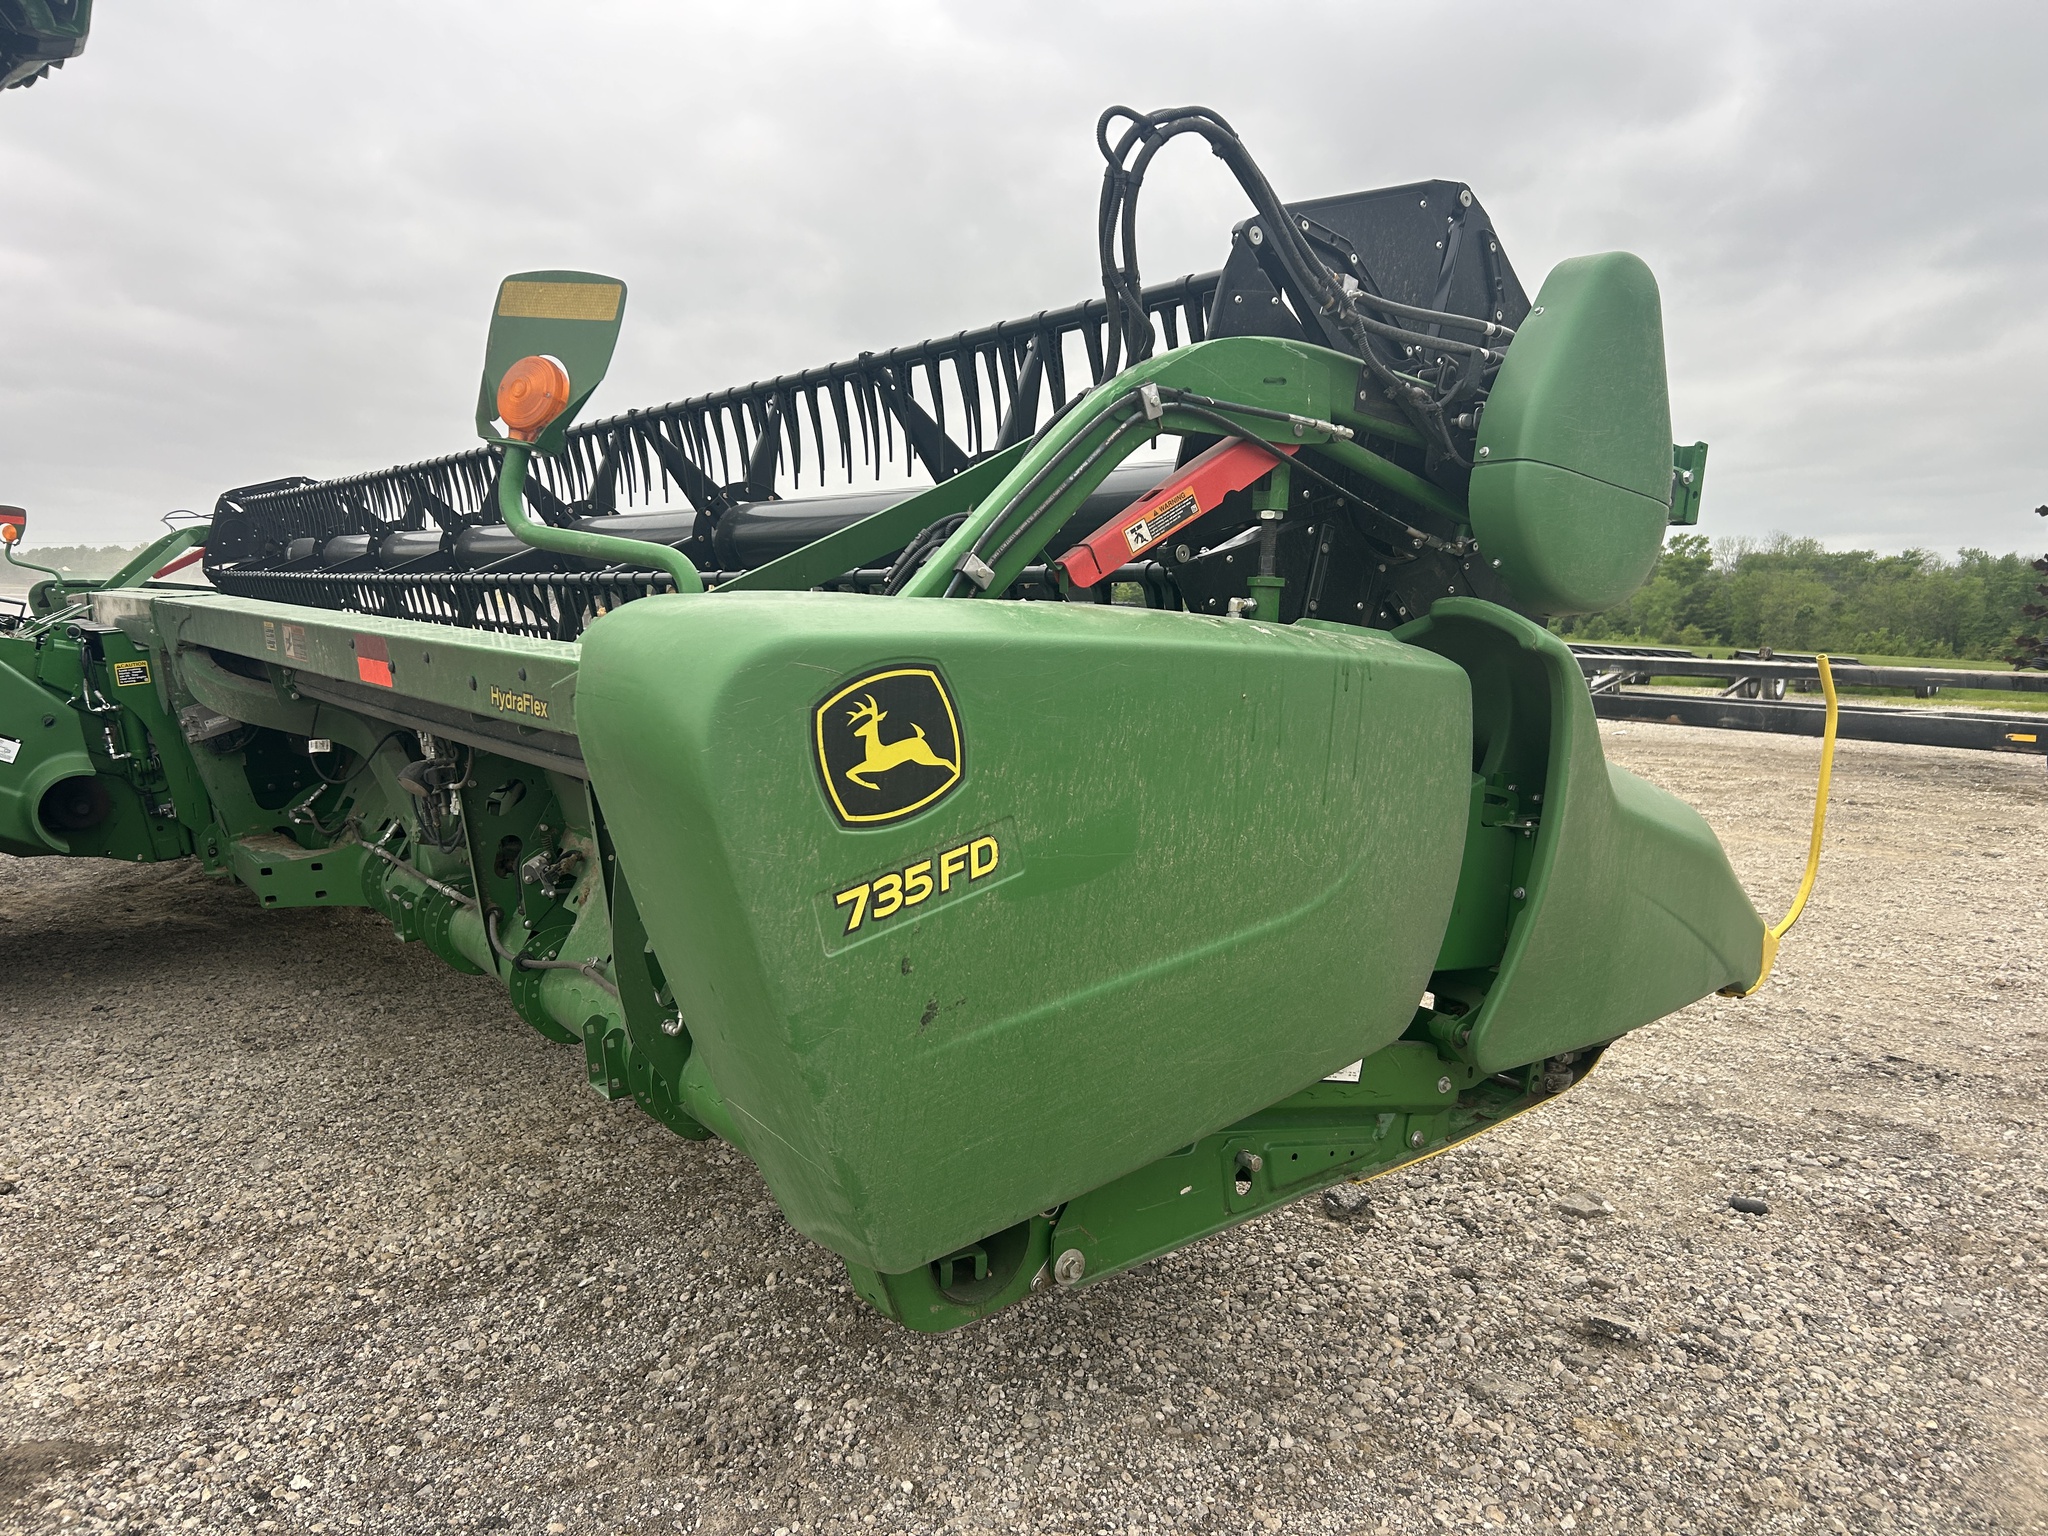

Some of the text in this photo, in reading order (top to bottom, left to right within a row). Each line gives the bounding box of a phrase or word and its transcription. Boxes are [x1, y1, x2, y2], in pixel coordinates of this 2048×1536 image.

[1159, 492, 1186, 512] WARNING
[120, 661, 147, 669] CAUTION
[490, 684, 549, 719] HydraFlex
[834, 835, 1000, 935] 735 FD
